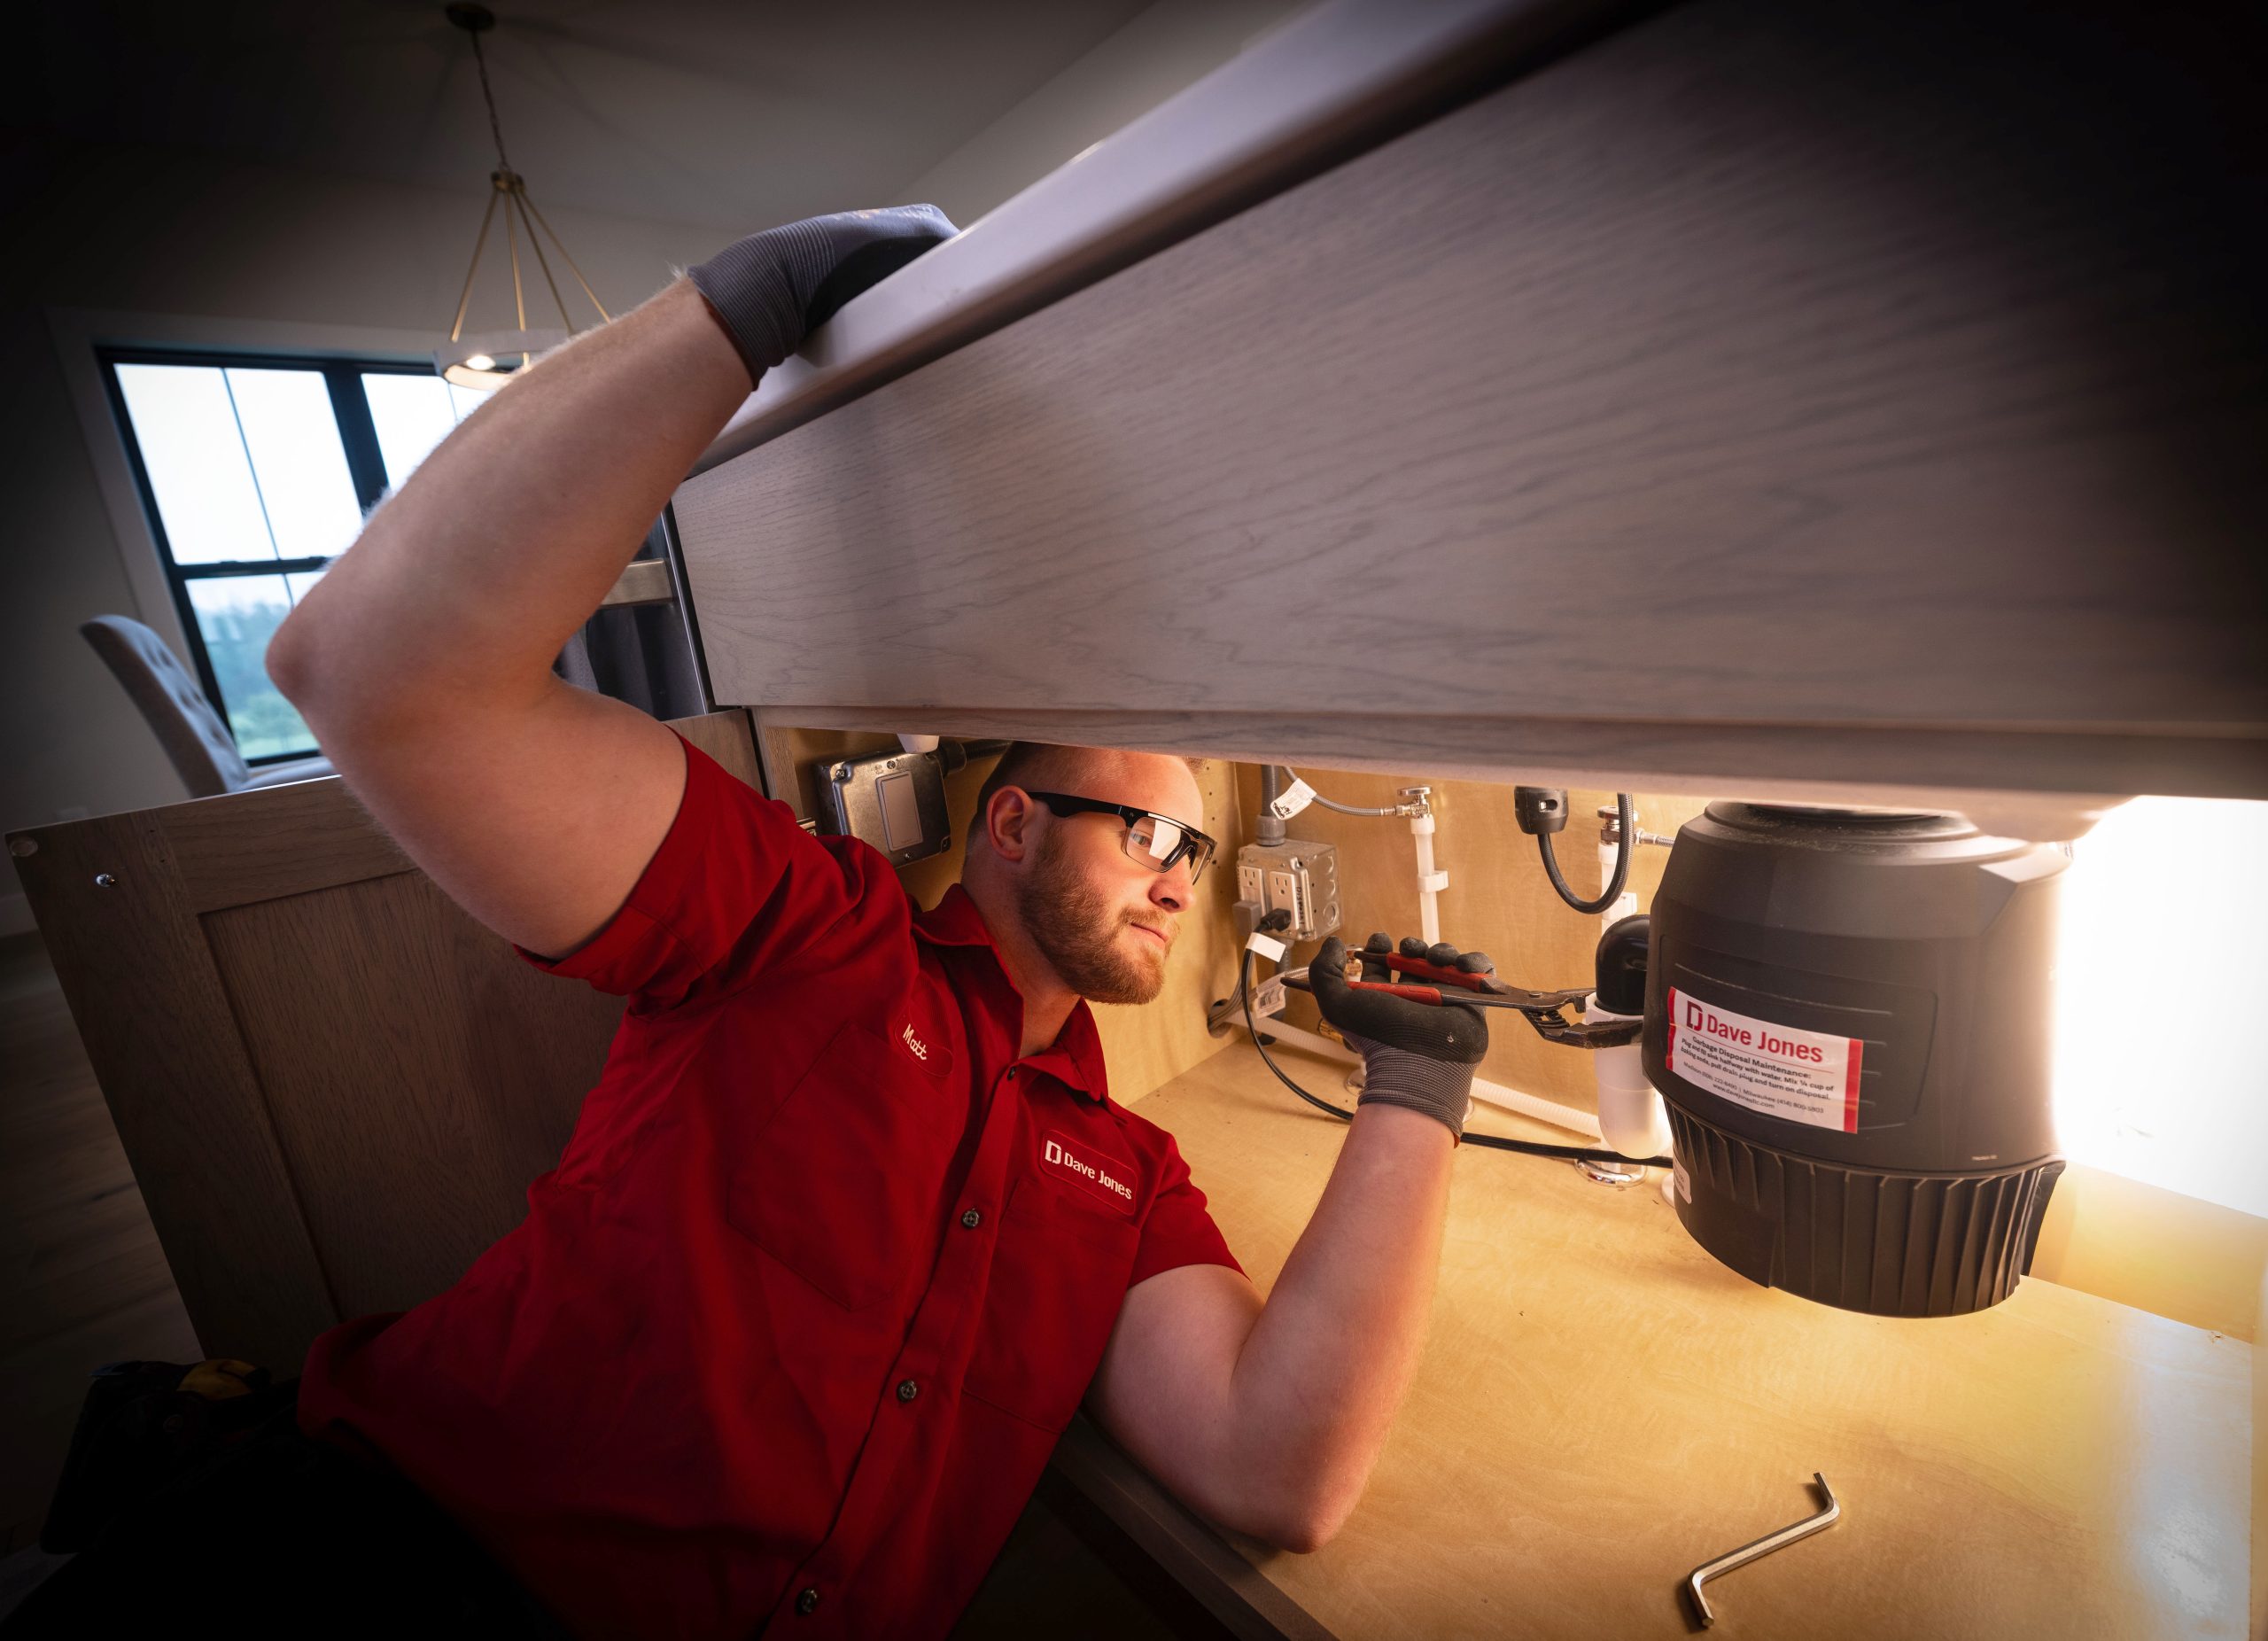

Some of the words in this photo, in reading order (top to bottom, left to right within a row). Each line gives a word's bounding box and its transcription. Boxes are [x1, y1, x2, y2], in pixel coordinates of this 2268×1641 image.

[902, 1023, 928, 1061] Matt
[1693, 1036, 1718, 1053] Garbage
[1719, 1047, 1751, 1064] Disposal
[1752, 1058, 1812, 1079] Maintenance:
[1706, 1014, 1751, 1046] Dave
[1758, 1030, 1823, 1062] Jones
[1681, 1046, 1697, 1060] baking
[1722, 1066, 1739, 1077] drain
[1739, 1072, 1753, 1083] plug
[1768, 1081, 1784, 1091] turn
[1720, 1056, 1744, 1071] halfway
[1745, 1066, 1759, 1075] with
[1784, 1077, 1797, 1085] Mix
[1064, 1151, 1096, 1179] Dave
[1098, 1170, 1133, 1200] Jones
